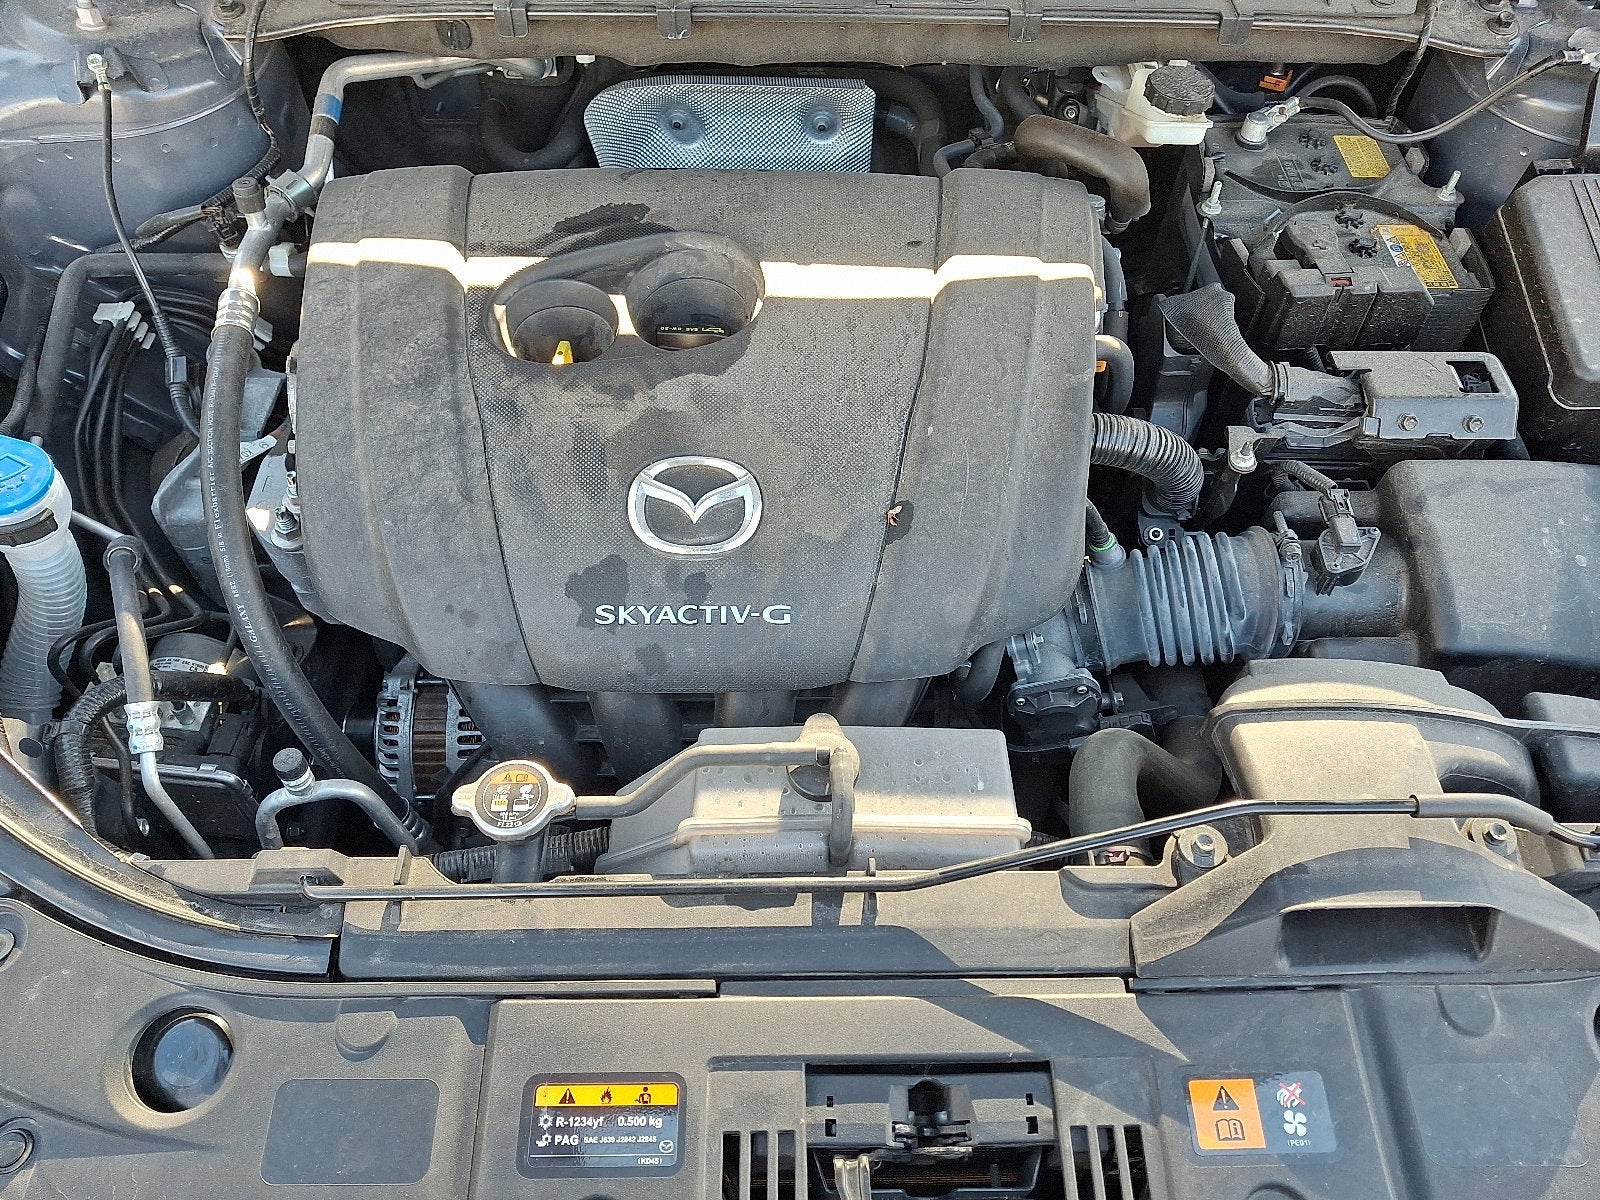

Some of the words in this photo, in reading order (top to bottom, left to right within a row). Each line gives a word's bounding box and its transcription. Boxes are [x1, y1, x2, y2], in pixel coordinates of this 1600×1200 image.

[208, 471, 222, 530] Flexbarrier
[594, 604, 791, 625] SKYACTIV-G
[555, 1116, 604, 1129] R-1234yf
[617, 1116, 646, 1127] 0.500
[648, 1116, 663, 1128] kg
[554, 1135, 579, 1146] PAG
